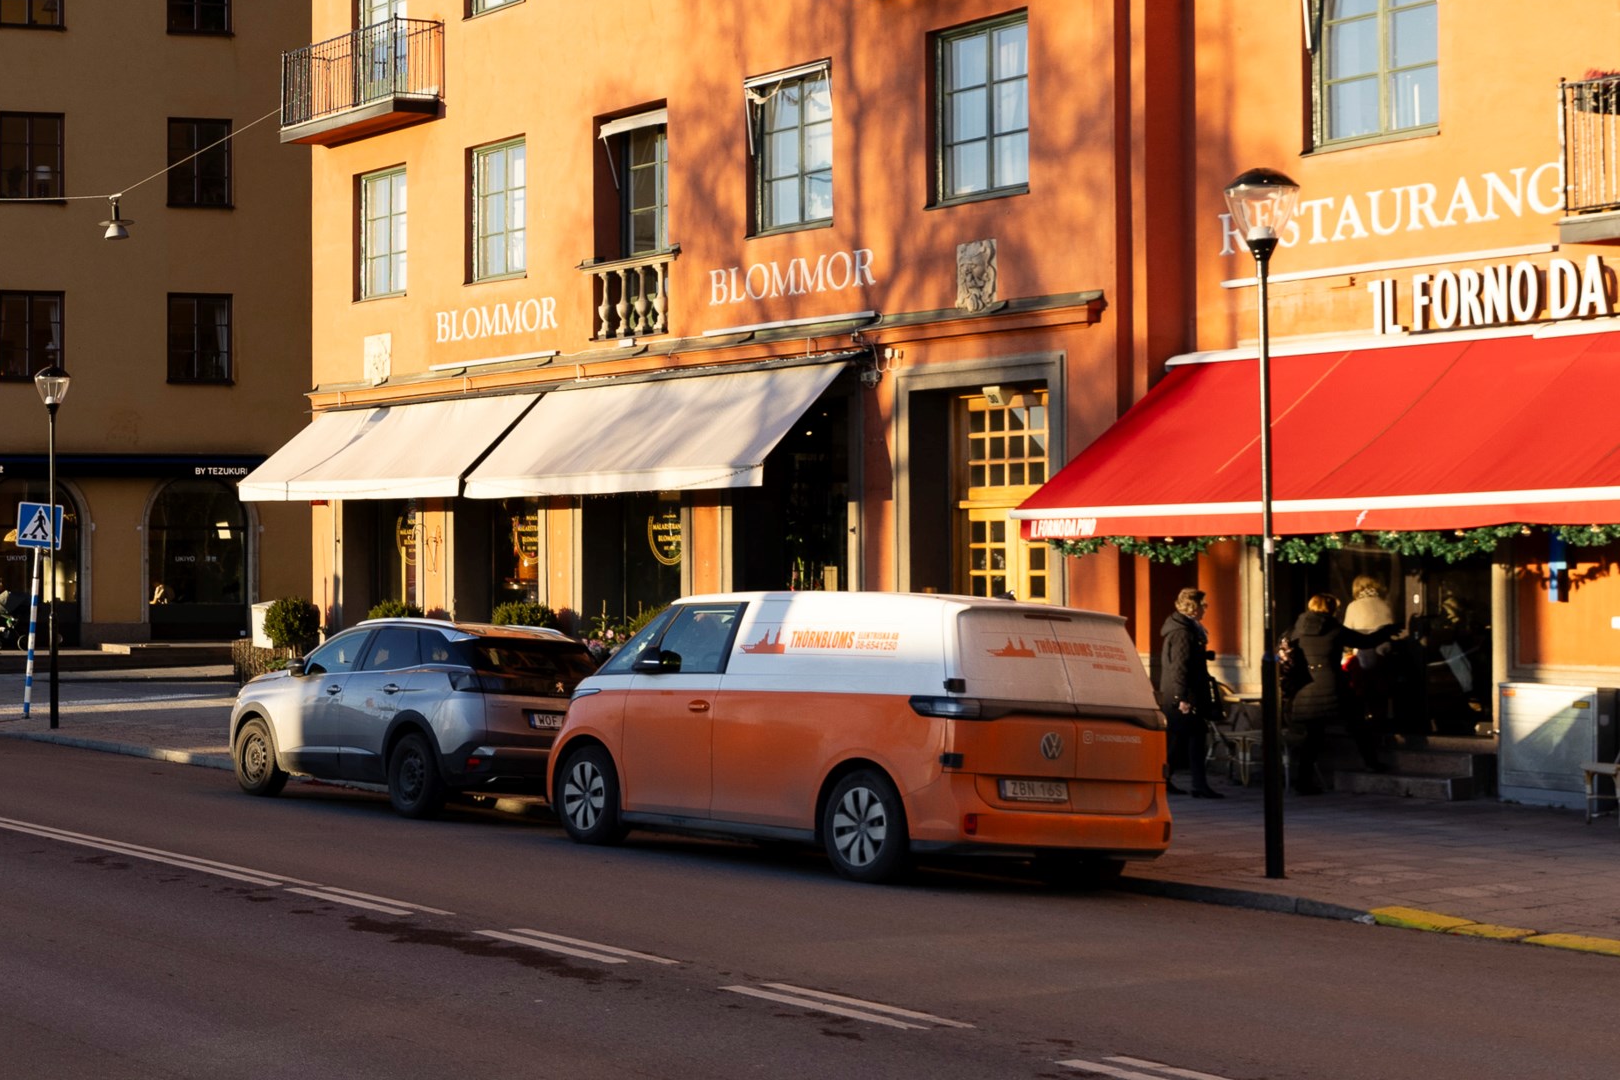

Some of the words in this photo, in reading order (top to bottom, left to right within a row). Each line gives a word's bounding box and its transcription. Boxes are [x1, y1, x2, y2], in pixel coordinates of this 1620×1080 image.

[1219, 161, 1574, 256] RESTAURANG
[709, 248, 876, 306] BLOMMOR
[1412, 260, 1539, 331] FORNO
[1549, 254, 1608, 319] DA
[436, 296, 558, 343] BLOMMOR
[195, 467, 206, 475] BY
[207, 467, 248, 475] TEZUKURI
[790, 629, 855, 649] THÖRNBLOMS
[1033, 639, 1094, 657] THÖRNBLOMS
[537, 715, 557, 726] WOF
[1011, 781, 1035, 796] ZBN
